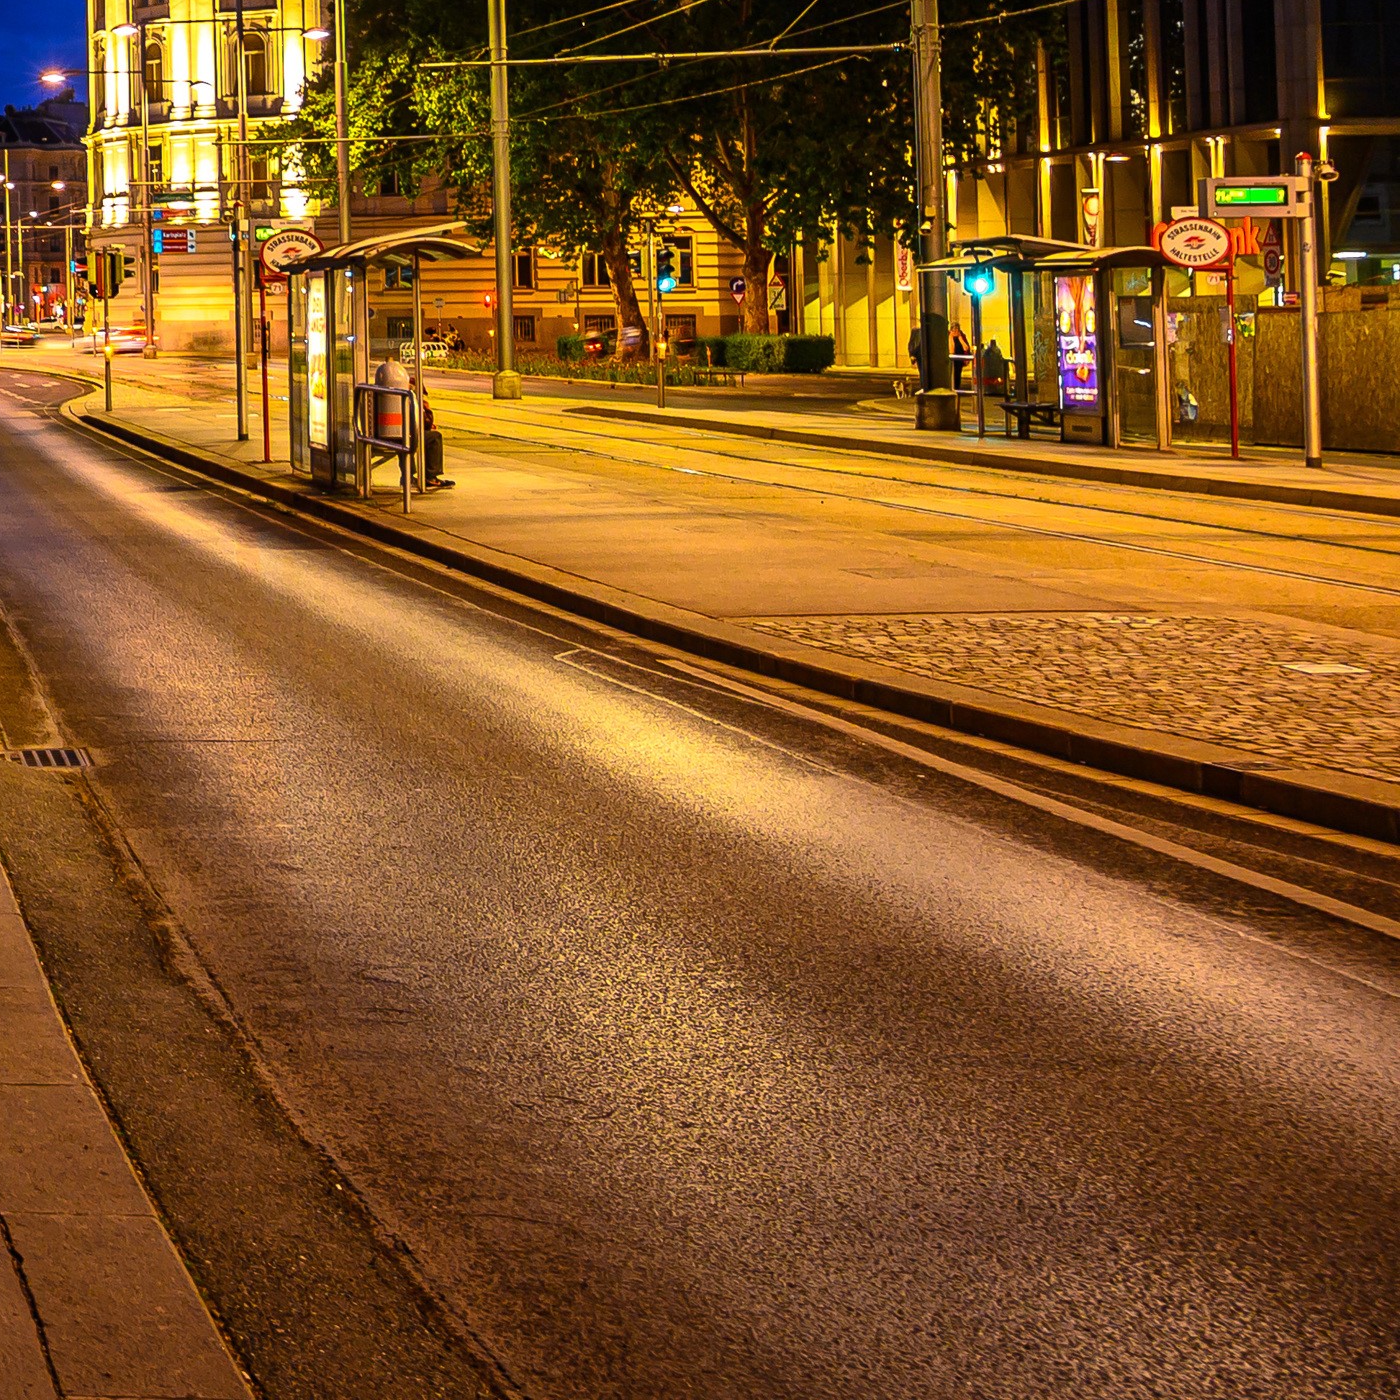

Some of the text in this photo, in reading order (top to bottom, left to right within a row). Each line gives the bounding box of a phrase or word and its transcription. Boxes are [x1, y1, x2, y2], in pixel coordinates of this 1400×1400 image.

[1167, 223, 1222, 241] STRASSENBAHN
[267, 234, 317, 252] STRASSENBAHN
[1170, 246, 1220, 262] HALTESTELLE
[274, 284, 281, 293] 71
